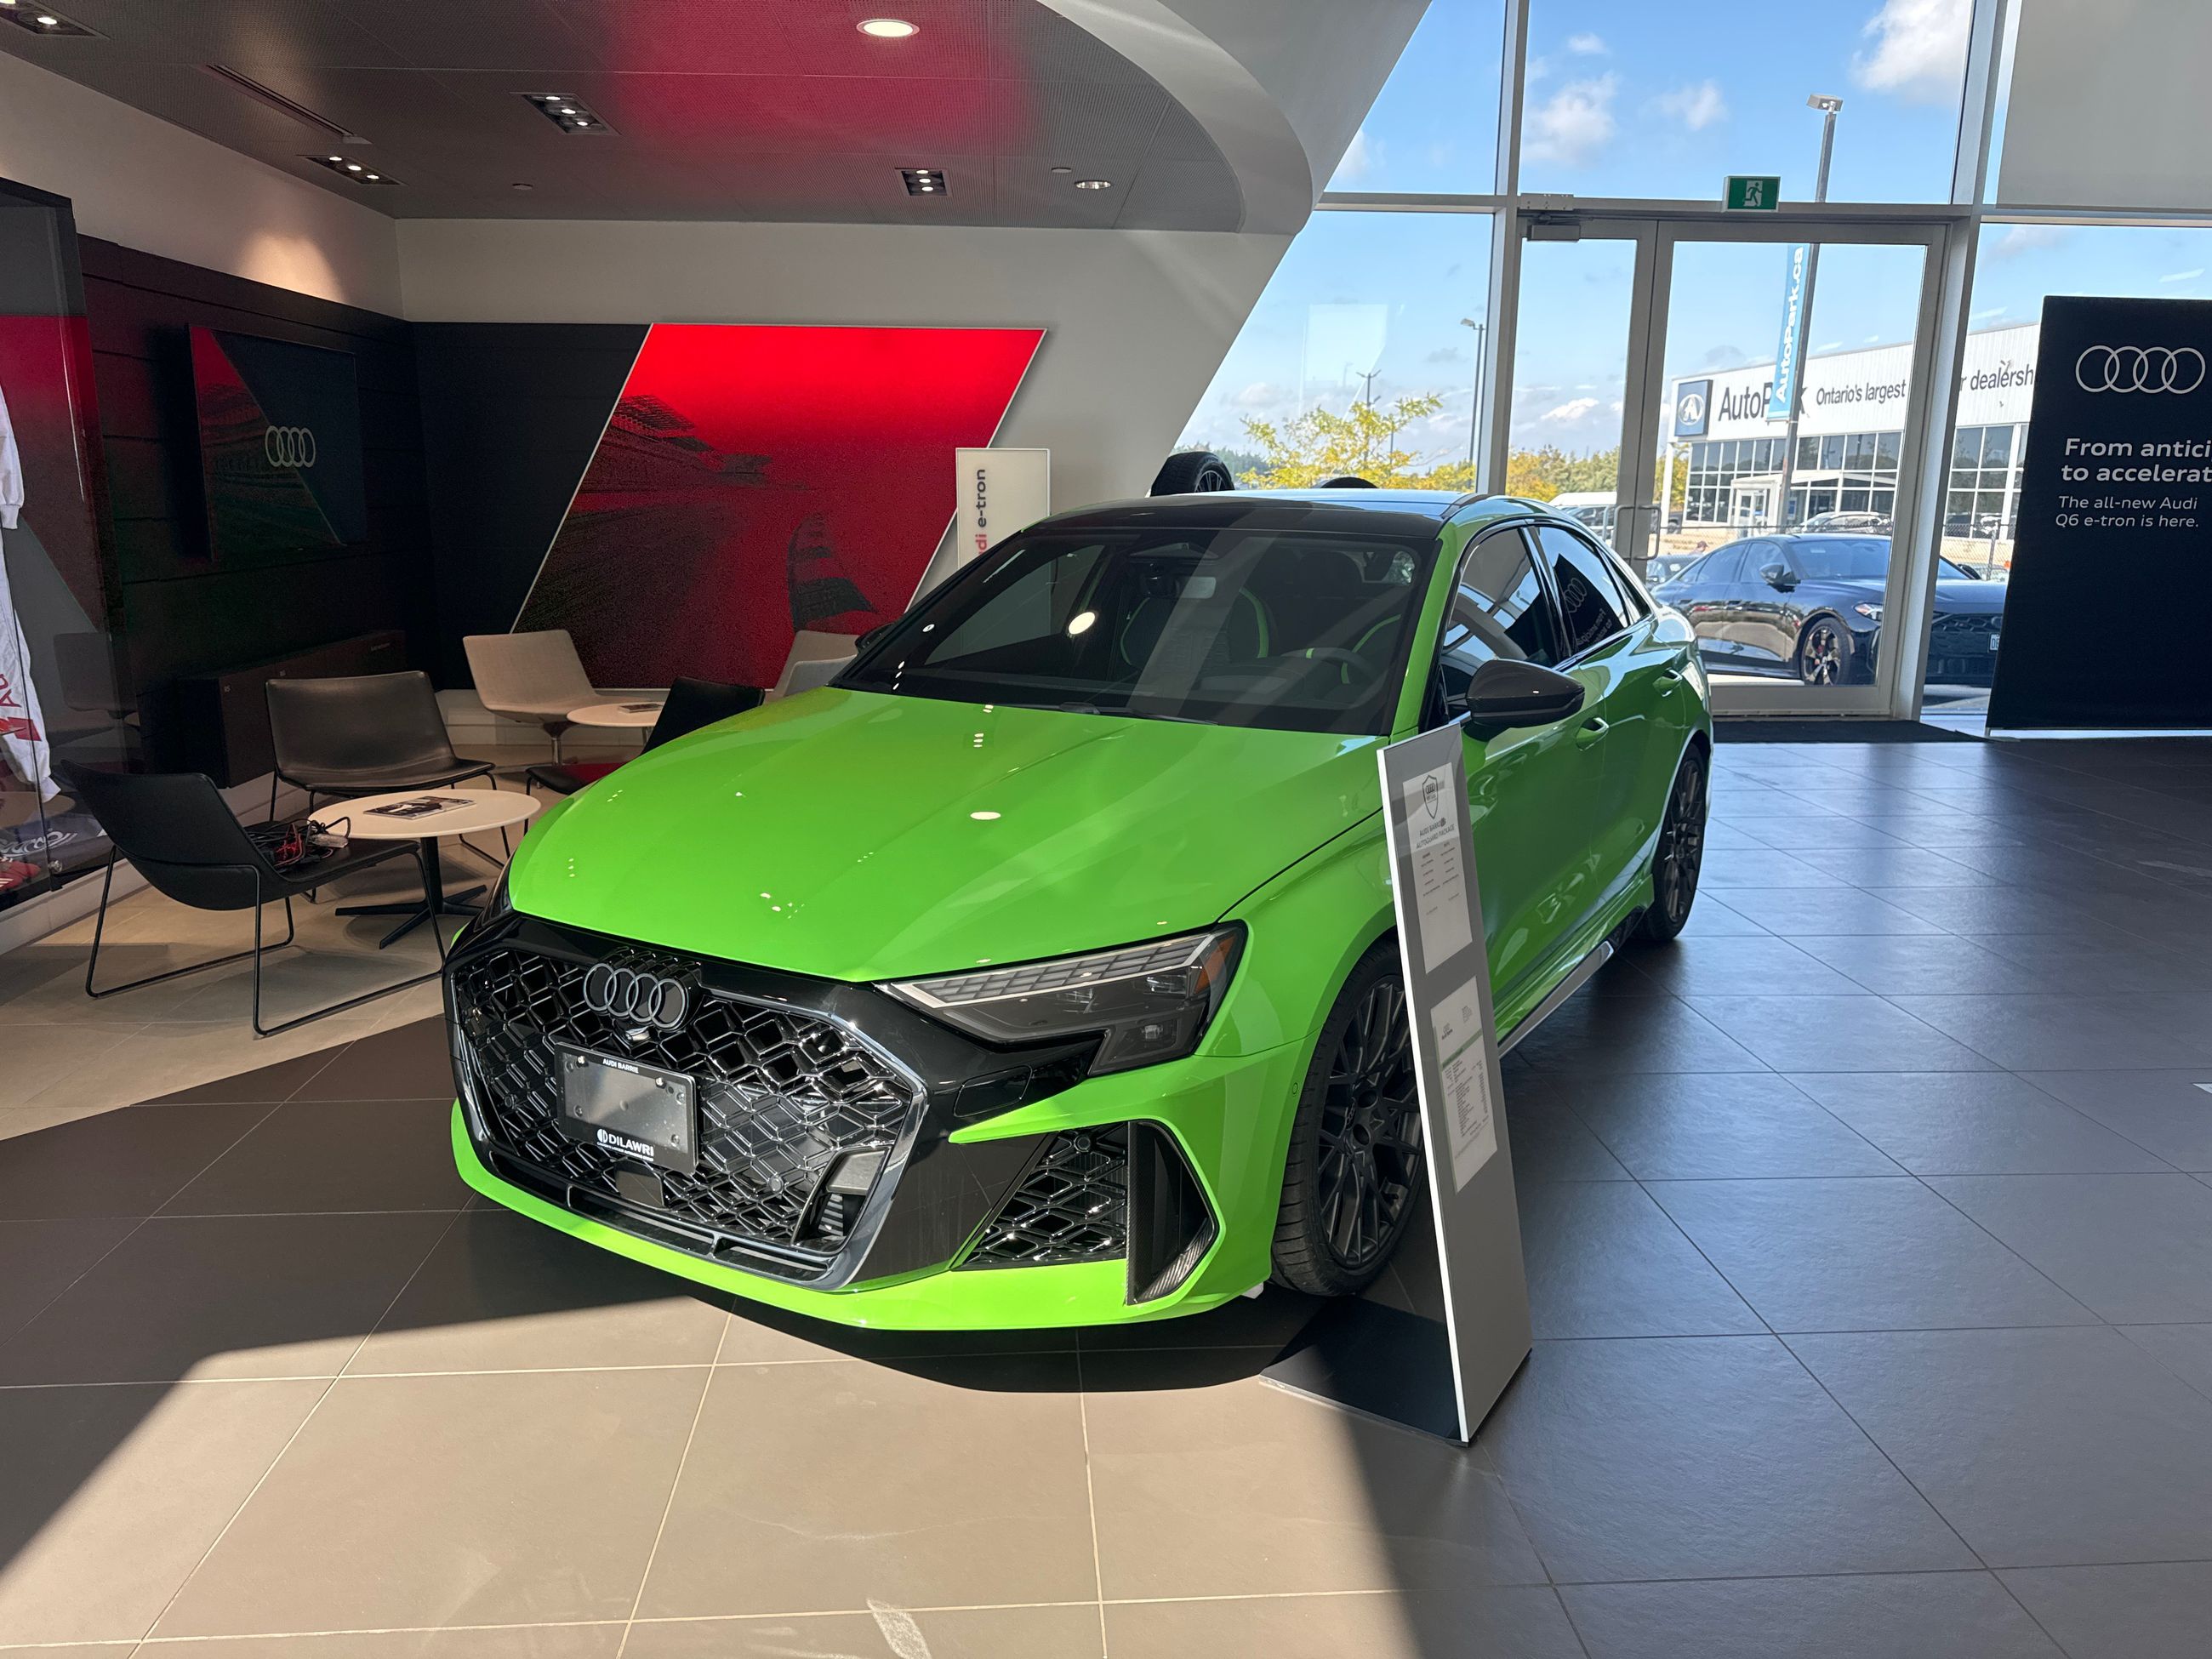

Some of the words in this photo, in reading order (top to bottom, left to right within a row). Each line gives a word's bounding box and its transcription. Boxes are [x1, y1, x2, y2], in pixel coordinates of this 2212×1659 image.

[1776, 247, 1804, 403] AutoPark.ca
[1816, 385, 1862, 405] Ontario's
[1865, 379, 1907, 404] largest
[1970, 363, 2034, 391] dealersh
[1719, 382, 1809, 421] AutoPk
[2065, 437, 2133, 457] From
[2140, 439, 2212, 462] antici
[2061, 465, 2089, 482] to
[2096, 464, 2212, 482] accelerat
[976, 469, 987, 527] e-tron
[2058, 496, 2089, 509] The
[2094, 496, 2156, 509] all-new
[2159, 497, 2198, 510] Audi
[2055, 513, 2079, 527] Q6
[2084, 514, 2135, 527] e-tron
[2141, 515, 2153, 527] is
[2158, 515, 2199, 527] here.
[975, 534, 987, 555] di
[603, 1058, 618, 1068] AUDI
[618, 1062, 639, 1074] BARRIE
[608, 1133, 654, 1157] DILAWRI
